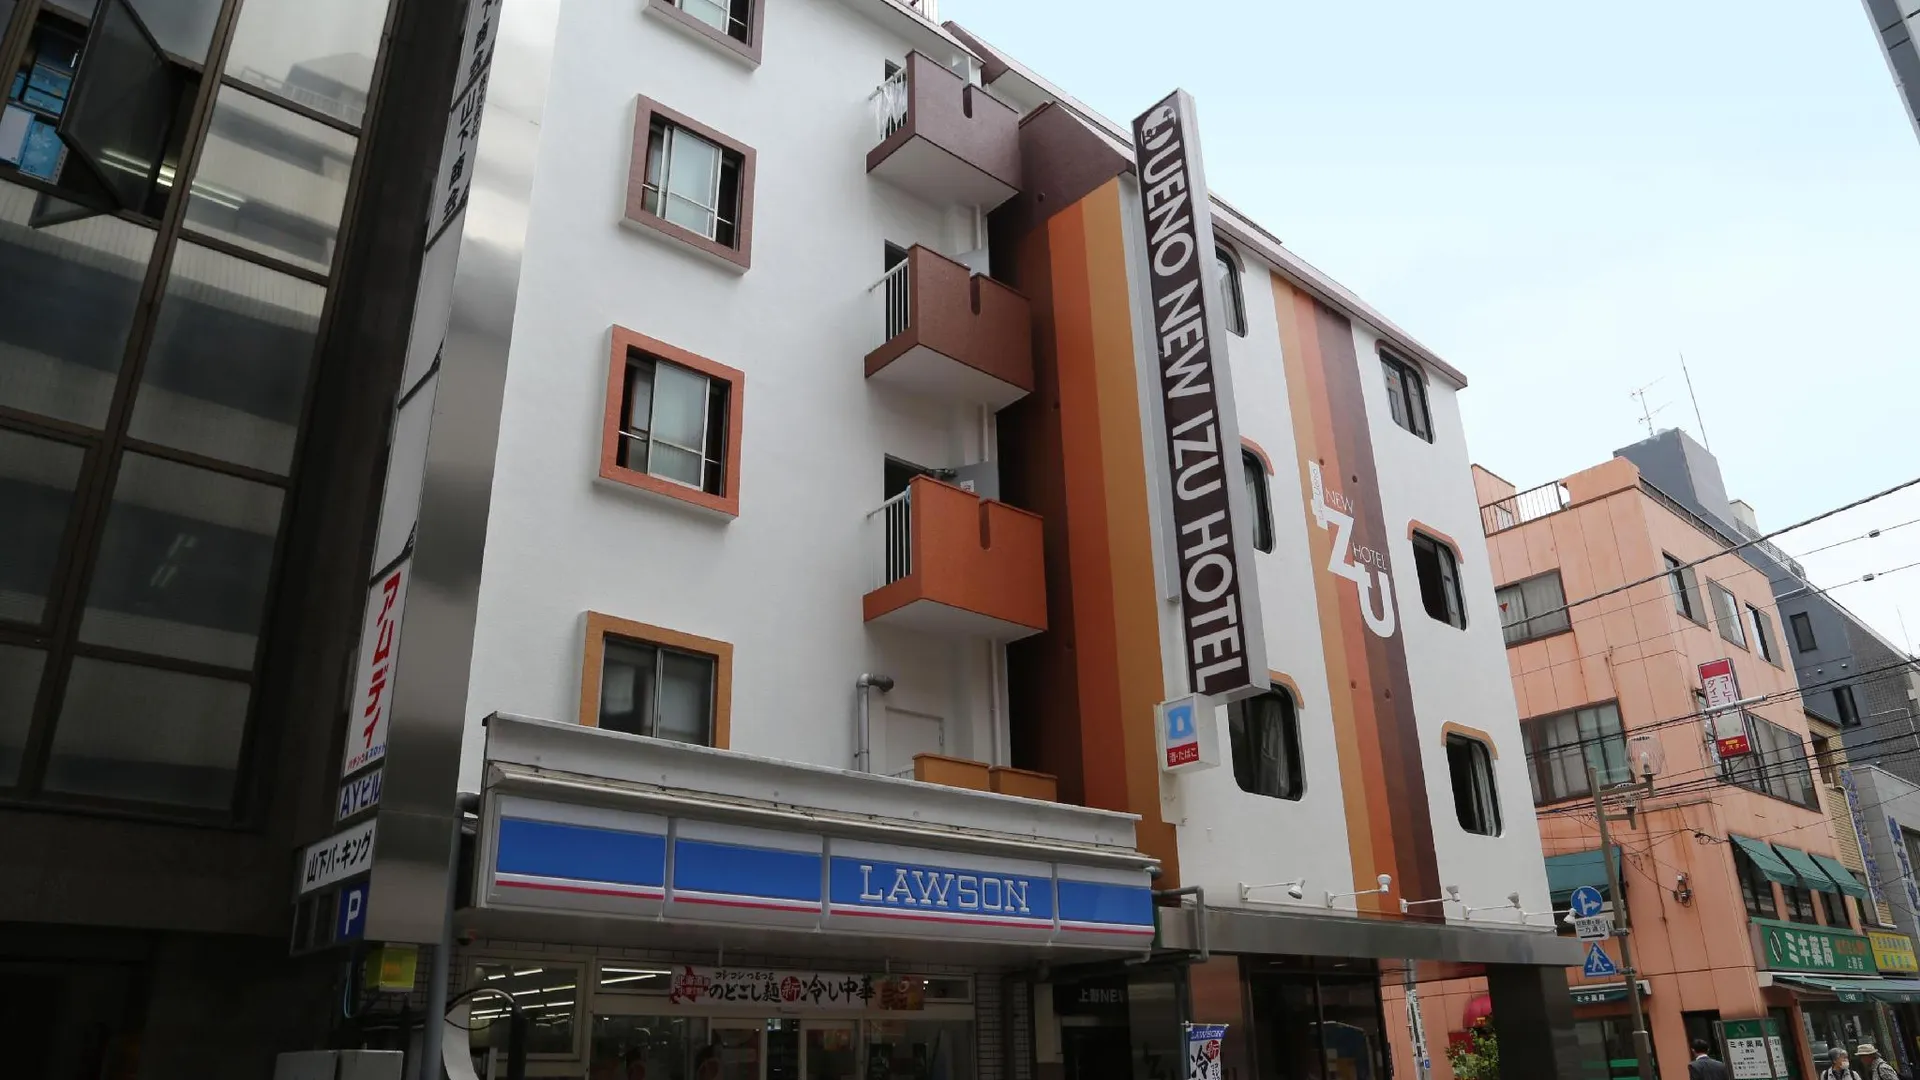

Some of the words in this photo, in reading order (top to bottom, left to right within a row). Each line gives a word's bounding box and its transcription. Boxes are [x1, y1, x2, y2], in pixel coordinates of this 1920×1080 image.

[1143, 139, 1196, 278] UENO
[1158, 279, 1211, 400] NEW
[1172, 408, 1223, 502] IZU
[1326, 488, 1354, 513] NEW
[1353, 544, 1388, 571] HOTEL
[1181, 508, 1244, 694] HOTEL
[362, 571, 401, 749] アムディ
[340, 772, 382, 819] AYビル
[344, 889, 362, 936] P
[859, 864, 1032, 915] LAWSON
[1784, 931, 1835, 968] ミキ薬局
[801, 973, 877, 1008] 冷し中華
